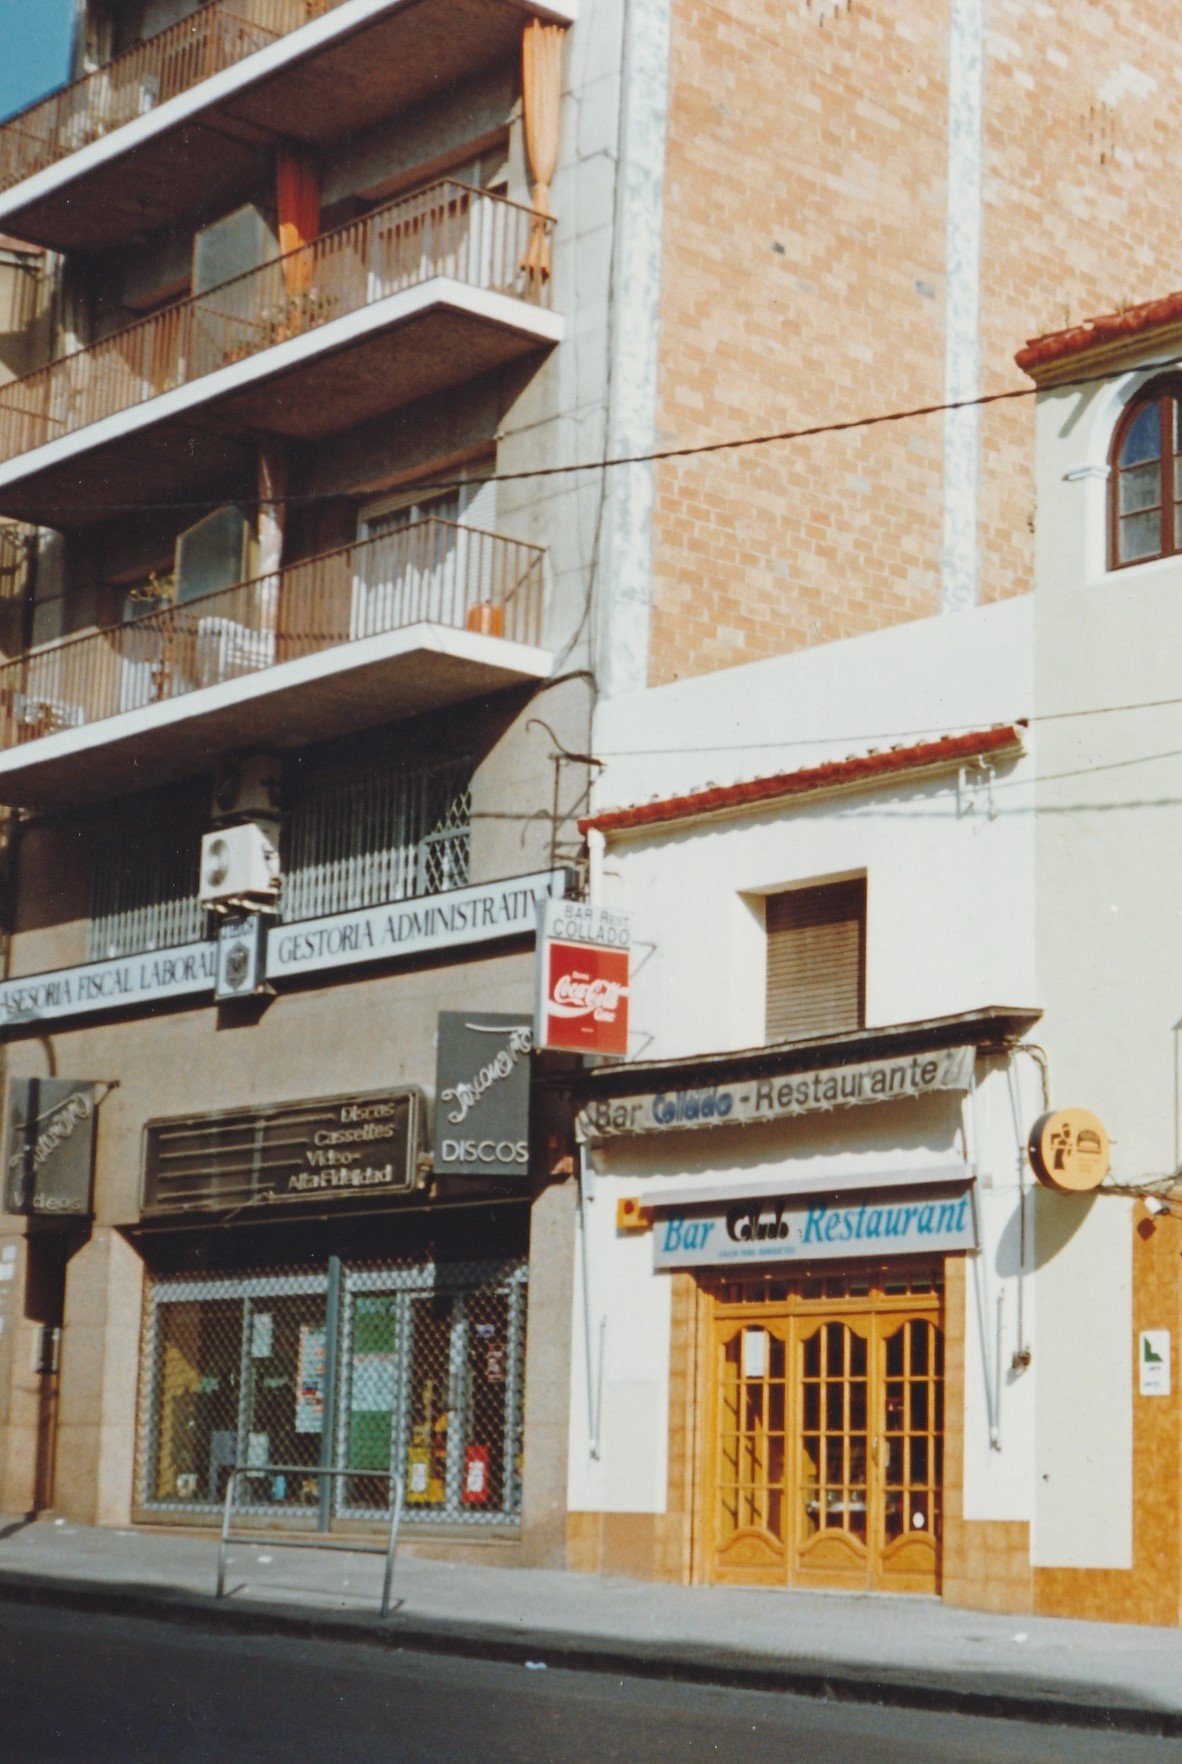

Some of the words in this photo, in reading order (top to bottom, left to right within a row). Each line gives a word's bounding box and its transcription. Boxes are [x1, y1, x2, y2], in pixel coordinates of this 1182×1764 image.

[564, 905, 593, 920] BAR
[278, 919, 374, 964] GESTORIA
[553, 918, 630, 945] COLLADO
[77, 967, 132, 999] FISCAL
[140, 951, 216, 989] LABORAL
[341, 1102, 395, 1122] Discos
[596, 1101, 642, 1129] Bar
[653, 1087, 733, 1124] Collado
[314, 1123, 395, 1146] Cassettes
[442, 1140, 530, 1163] DISCOS
[662, 1210, 715, 1252] Bar
[801, 1196, 969, 1244] Restaurant
